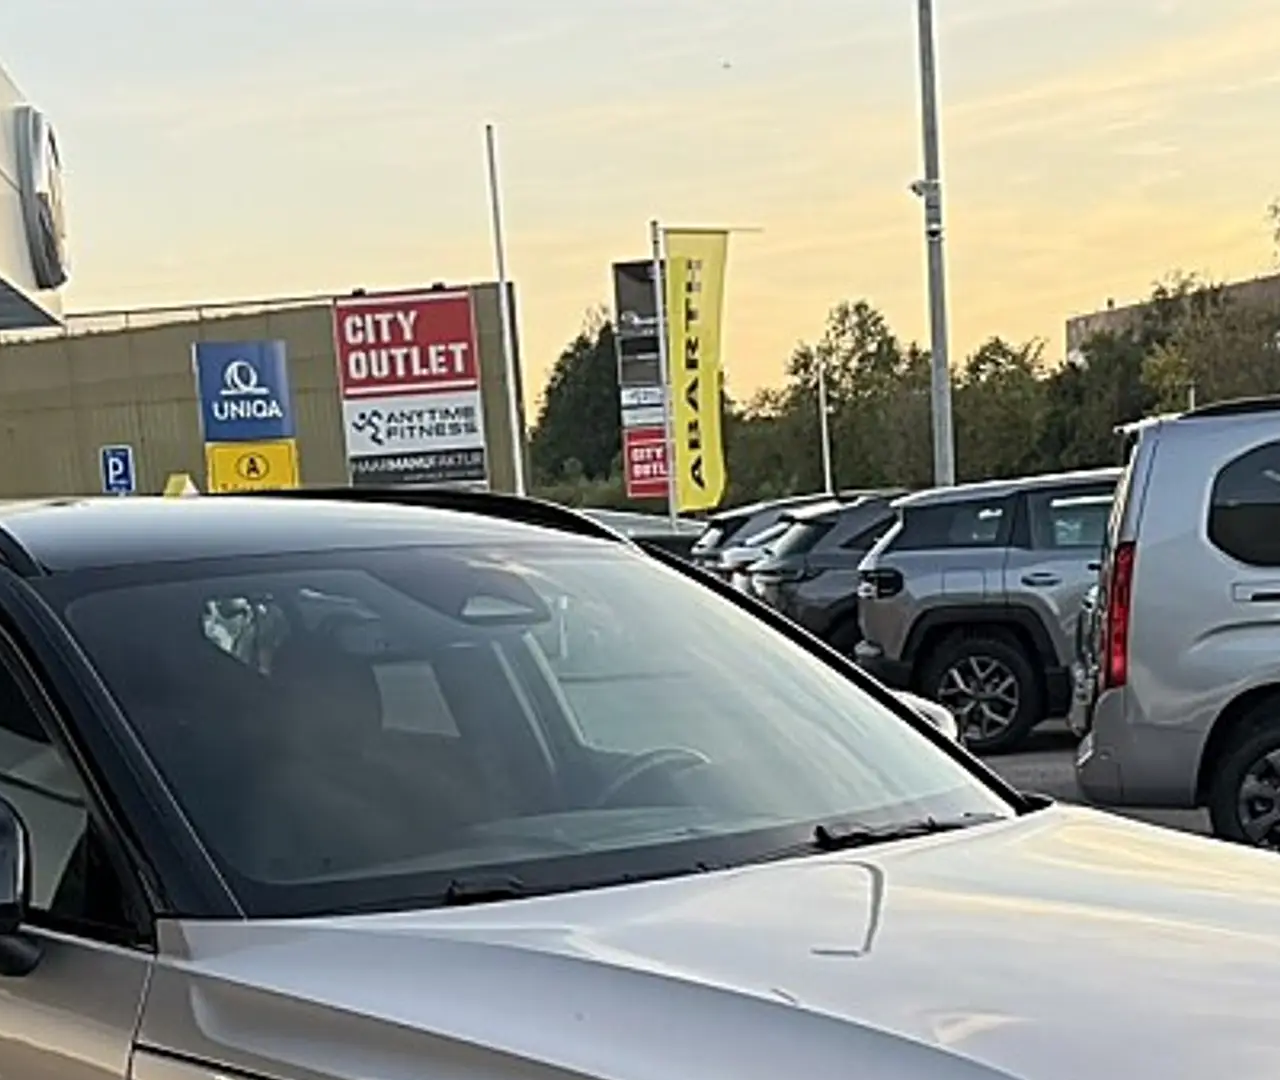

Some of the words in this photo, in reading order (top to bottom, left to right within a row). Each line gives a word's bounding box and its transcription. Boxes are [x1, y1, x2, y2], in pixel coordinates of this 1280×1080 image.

[344, 310, 418, 345] CITY
[348, 341, 468, 380] OUTLET
[684, 259, 705, 490] ABARTH
[211, 400, 284, 420] UNIQA
[386, 405, 475, 424] ANYTIME
[386, 422, 477, 440] FITNESS
[108, 456, 124, 485] P
